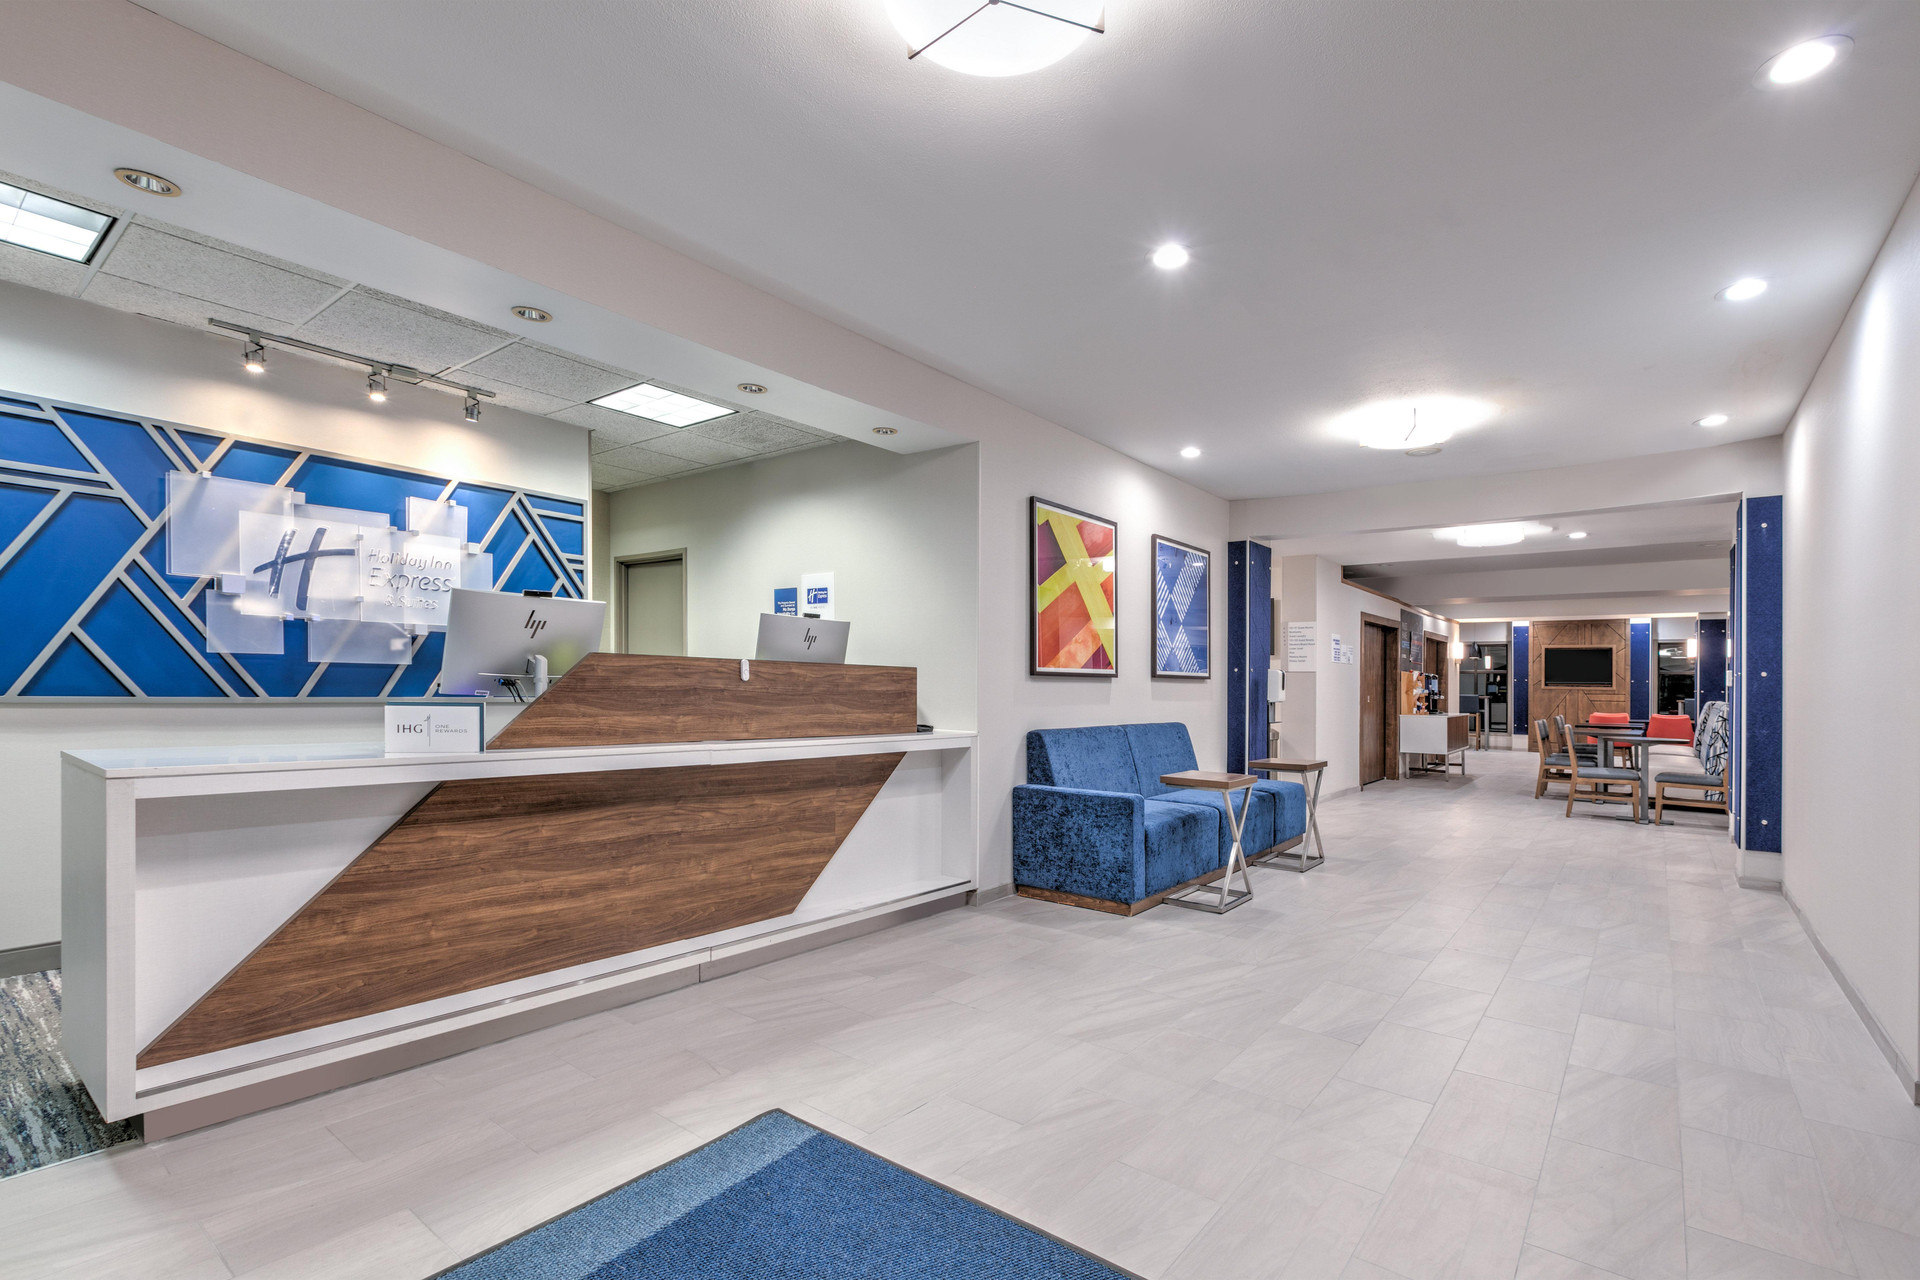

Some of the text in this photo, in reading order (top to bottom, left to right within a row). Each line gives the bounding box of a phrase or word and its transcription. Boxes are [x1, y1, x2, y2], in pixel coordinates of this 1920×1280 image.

[368, 548, 453, 571] Holiday Inn
[368, 567, 454, 593] Express
[384, 595, 439, 610] & Suites
[396, 723, 423, 734] IHG
